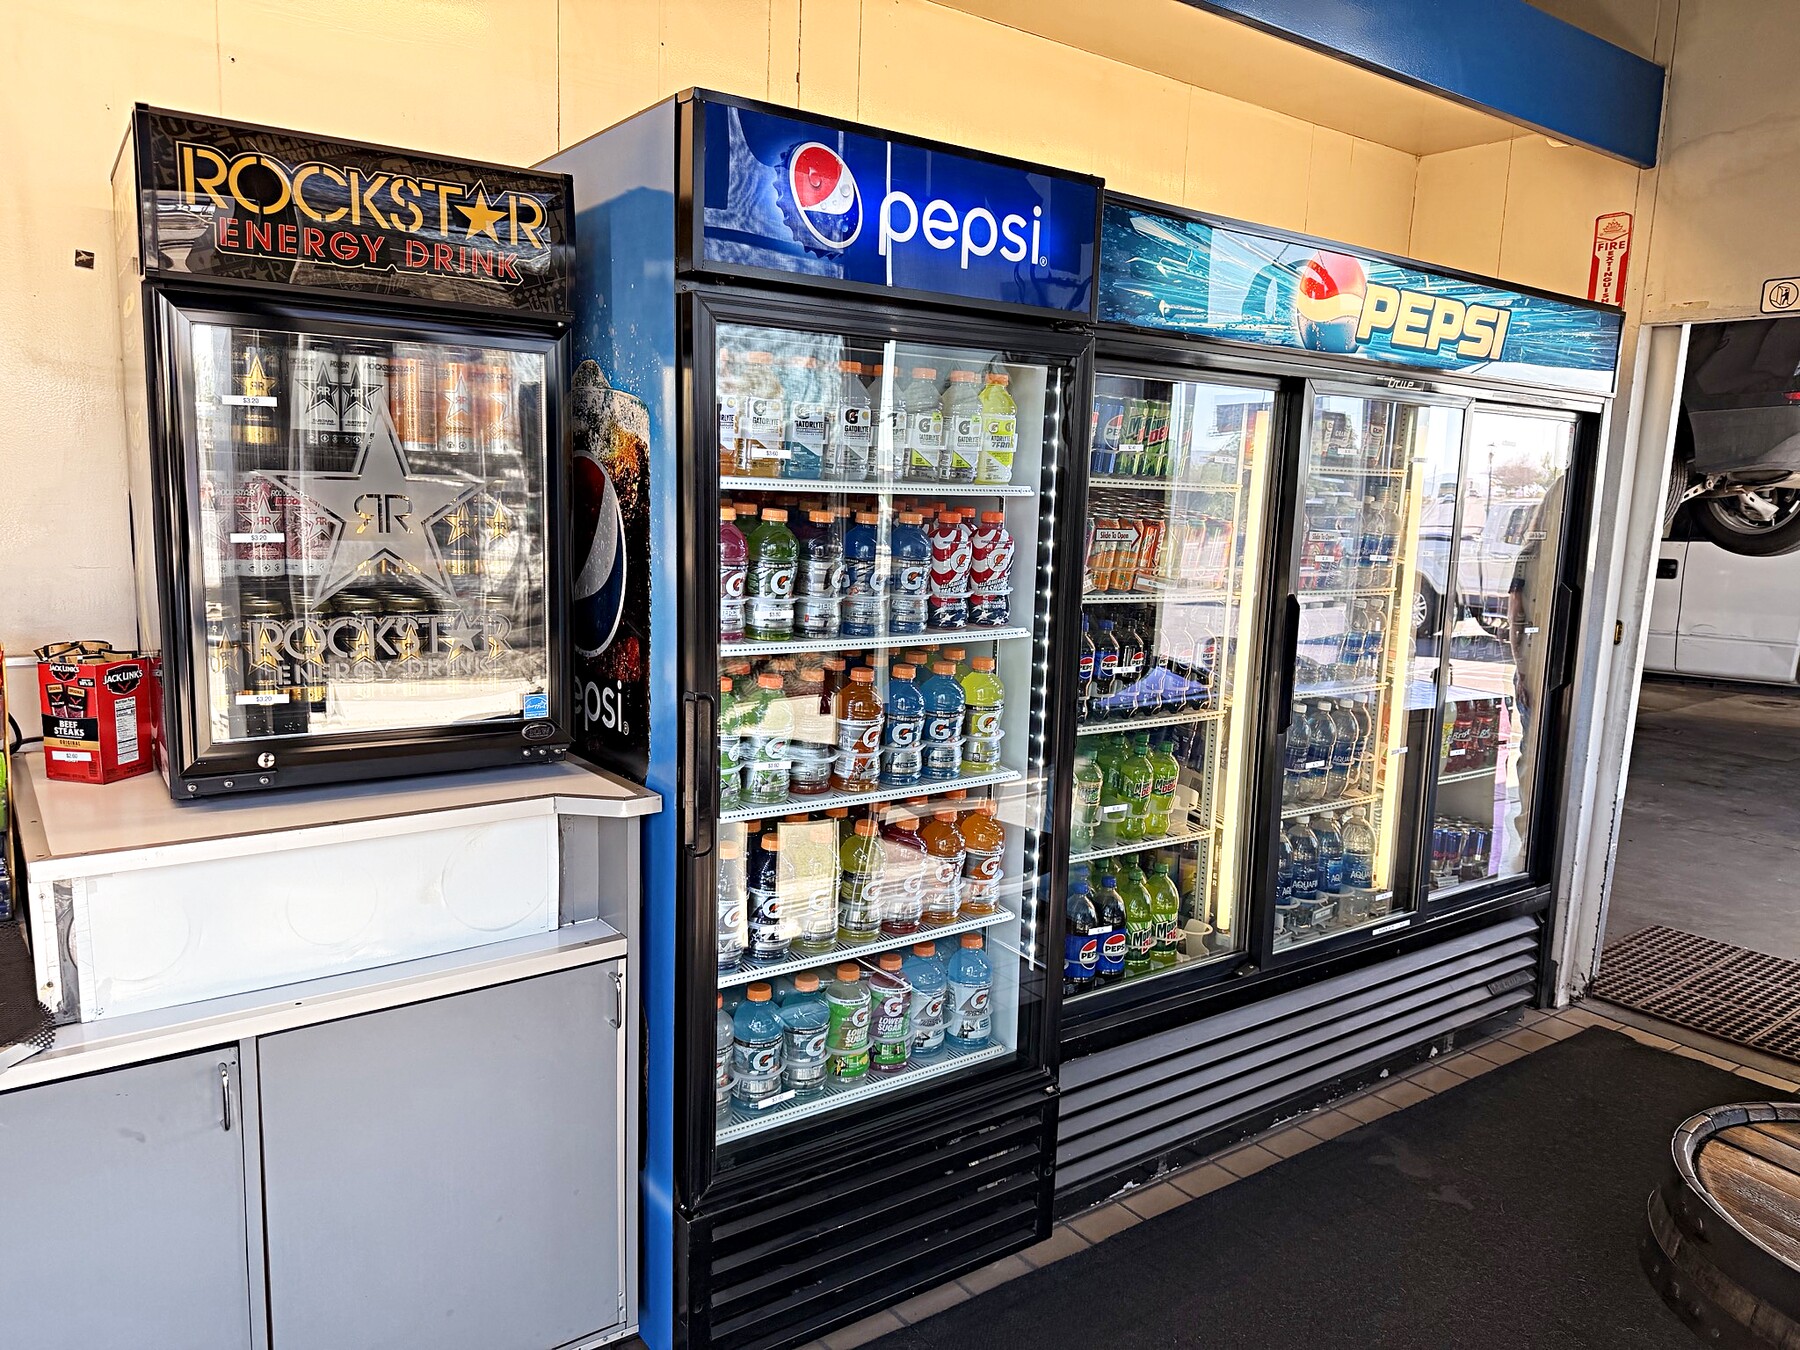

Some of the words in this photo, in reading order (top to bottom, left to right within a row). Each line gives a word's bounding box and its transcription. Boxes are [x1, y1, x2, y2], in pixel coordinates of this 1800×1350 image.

[183, 147, 544, 250] ROCKSTAR
[878, 190, 1043, 270] pepsi
[219, 217, 385, 263] ENERGY
[406, 239, 519, 280] DRINK
[1597, 240, 1625, 252] FIRE
[1356, 283, 1511, 361] PEPSI
[770, 570, 793, 595] G
[901, 567, 923, 590] G
[103, 673, 123, 685] JACK
[122, 669, 143, 681] LINK'S
[277, 660, 392, 686] ENERGY
[406, 658, 492, 677] DRINK
[53, 726, 85, 737] STEAKS
[59, 719, 78, 729] BEEF
[892, 723, 915, 746] G
[929, 719, 952, 740] G
[981, 856, 1000, 876] G
[884, 996, 904, 1017] G
[970, 990, 989, 1010] G
[878, 1016, 904, 1025] LOWER
[806, 1035, 826, 1057] G
[753, 1049, 775, 1072] G
